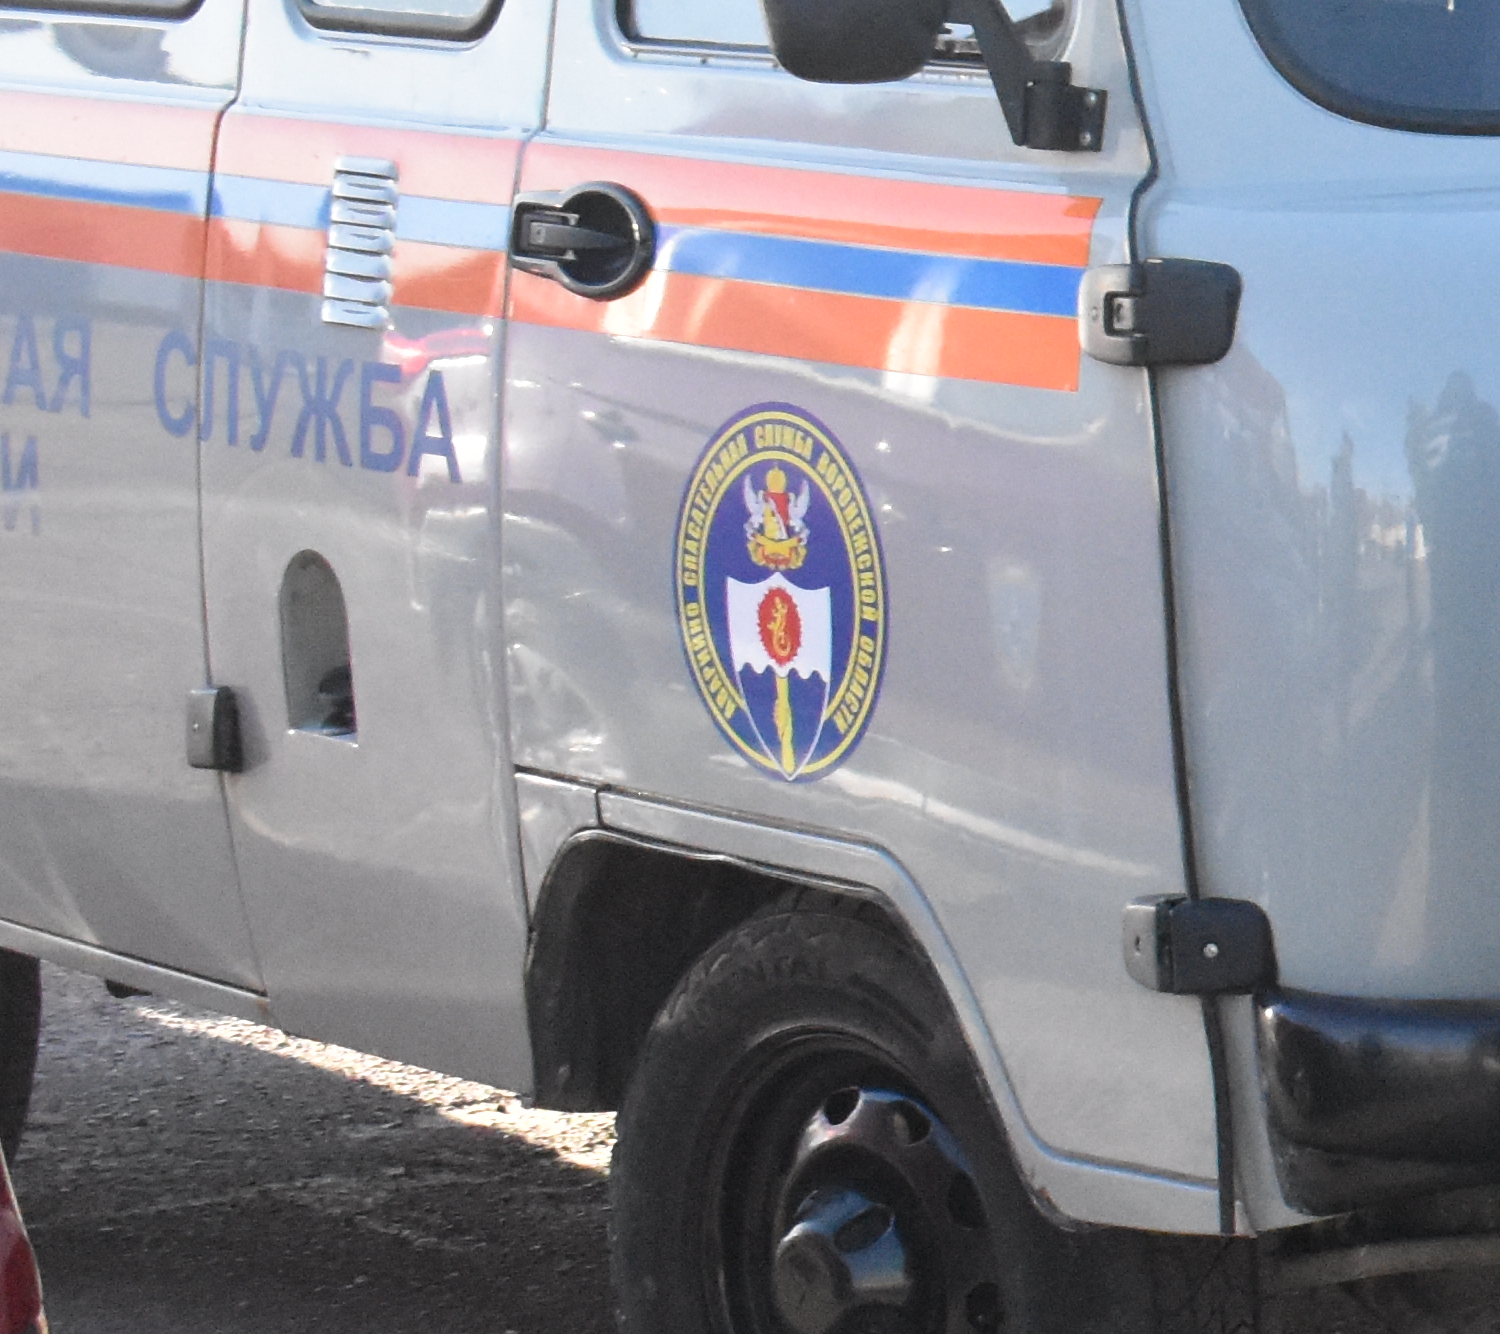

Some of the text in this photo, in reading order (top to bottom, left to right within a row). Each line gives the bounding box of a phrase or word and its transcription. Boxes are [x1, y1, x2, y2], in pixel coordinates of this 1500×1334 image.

[154, 327, 463, 484] СЛУЖБА
[754, 424, 814, 462] СЛУЖБА
[834, 635, 876, 735] ОБЛАСТИ
